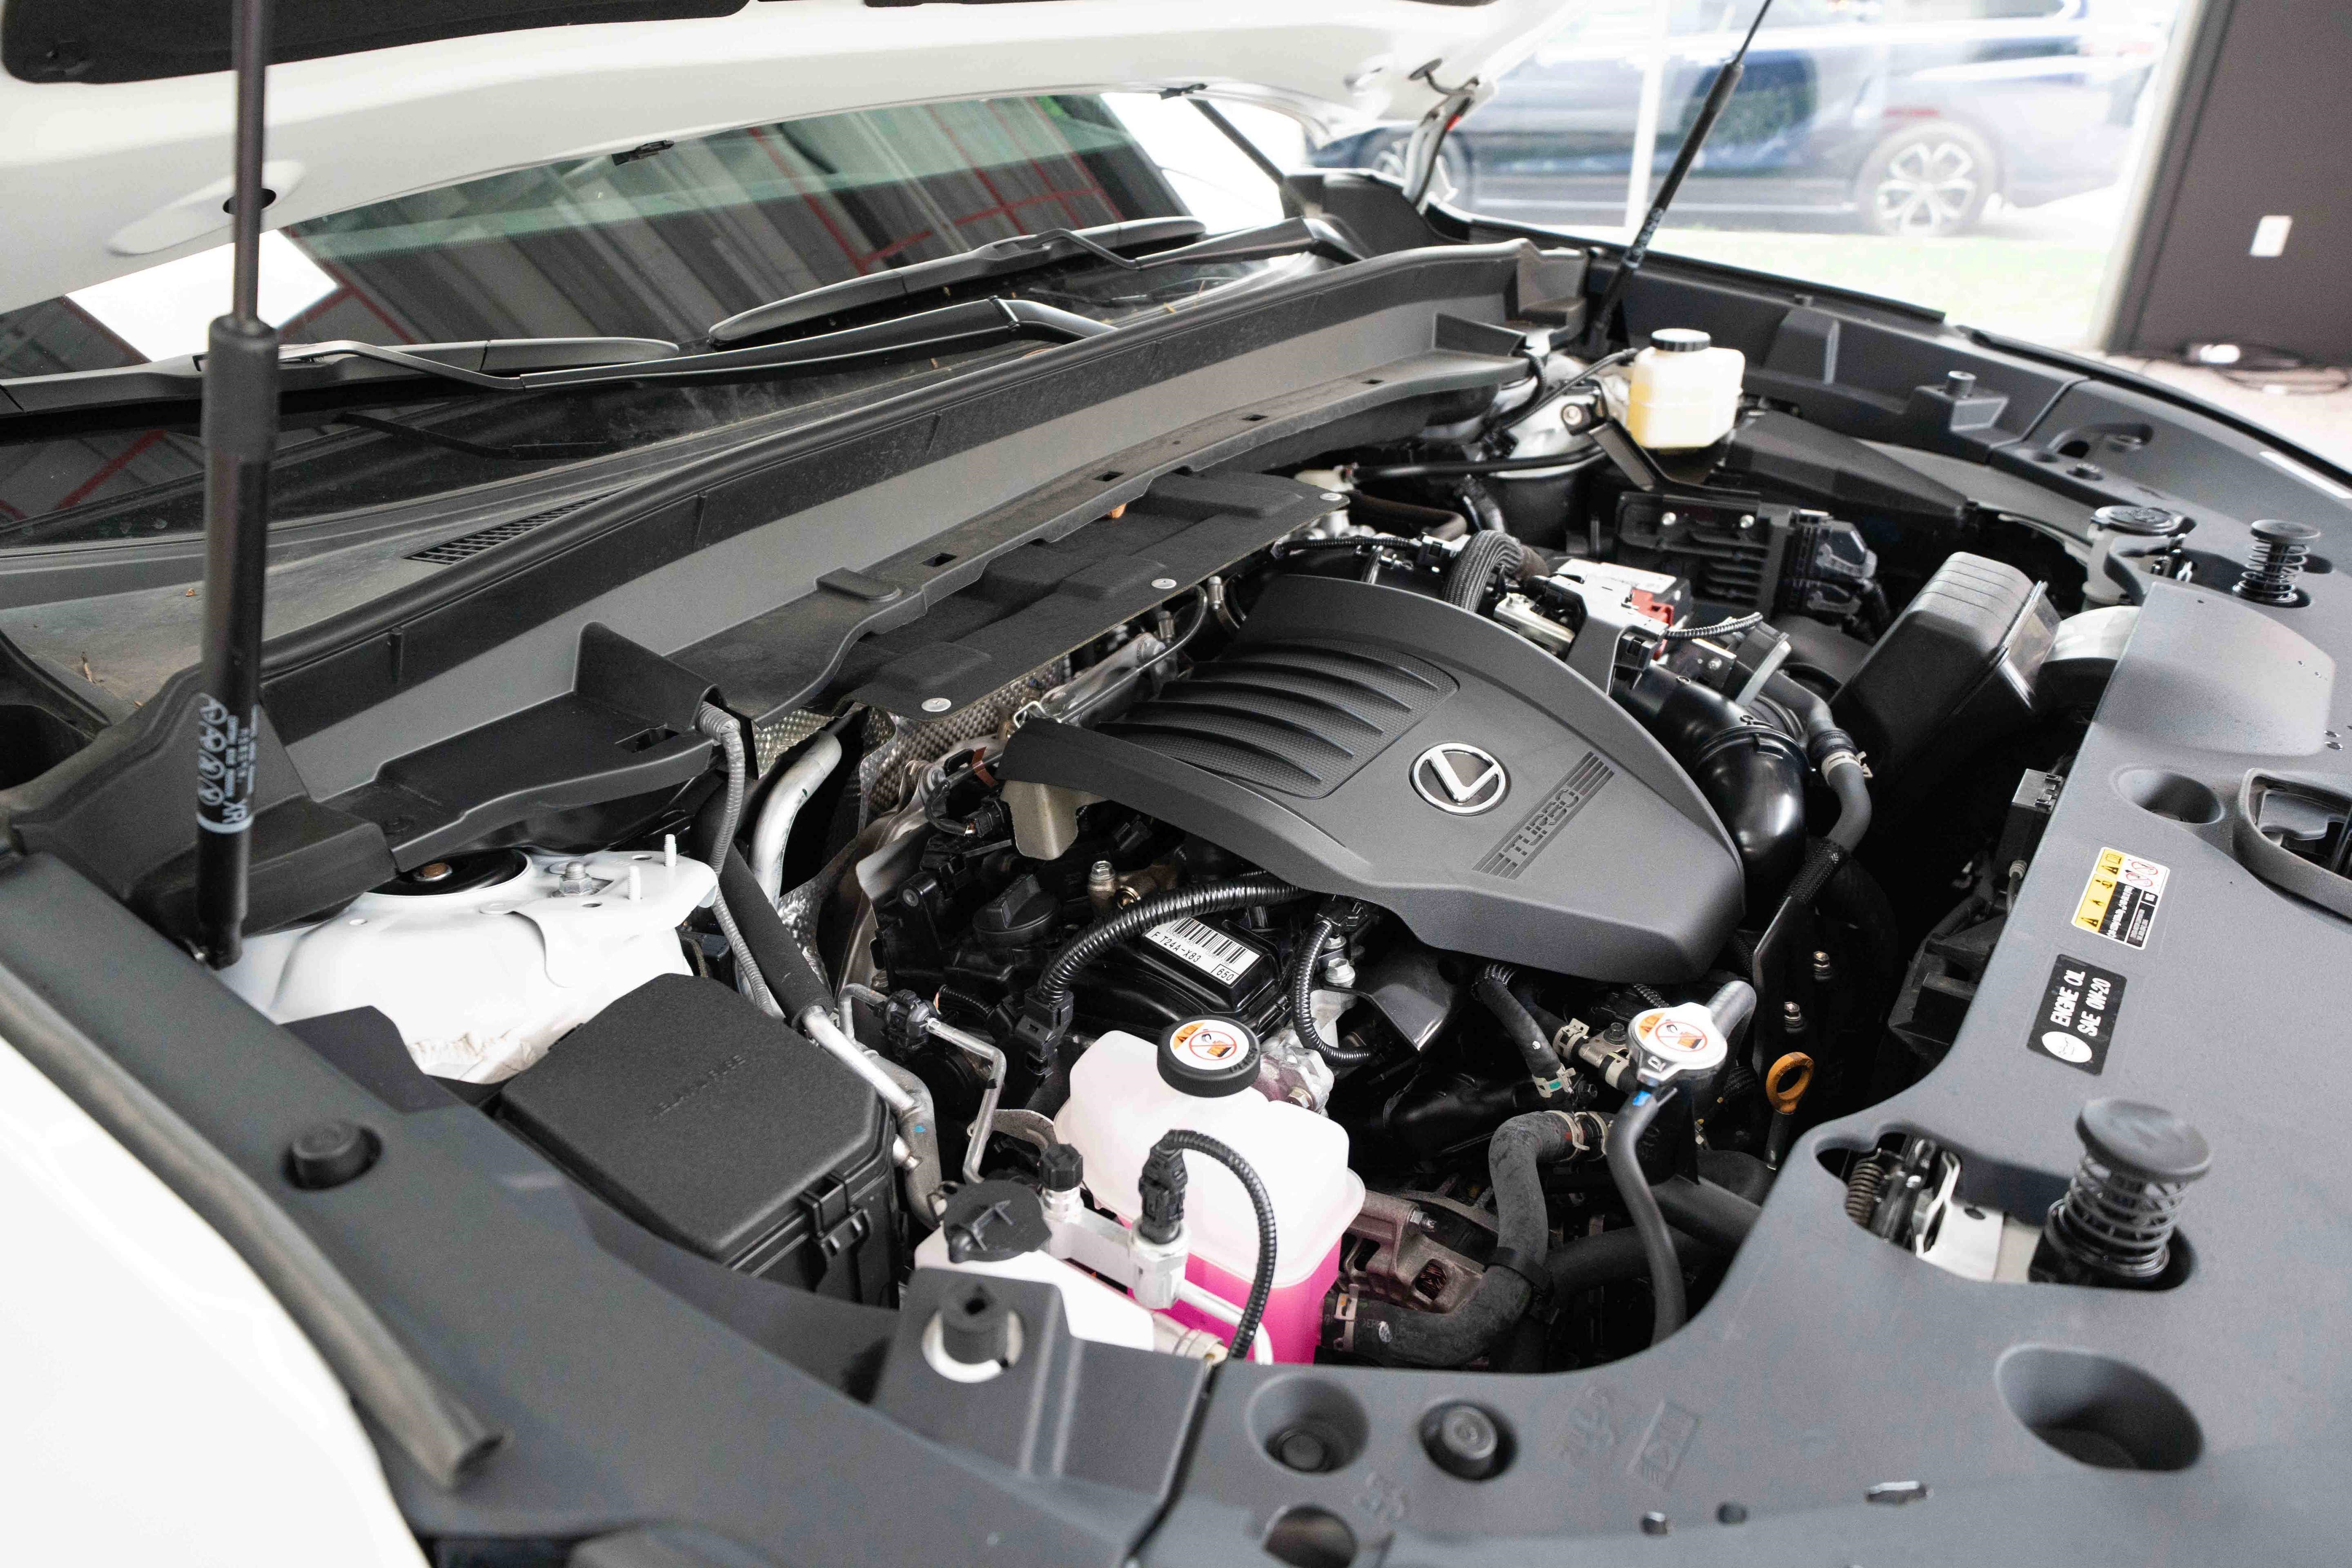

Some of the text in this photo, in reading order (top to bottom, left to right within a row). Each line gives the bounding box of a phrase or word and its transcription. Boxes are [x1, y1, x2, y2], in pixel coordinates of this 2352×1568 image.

[1503, 789, 1579, 856] TURBO
[1160, 936, 1201, 962] T24A-X83
[1216, 968, 1234, 981] 650
[2064, 970, 2085, 986] OIL
[2050, 987, 2079, 1027] ENGINE
[2077, 978, 2111, 1036] SAE 0W-20
